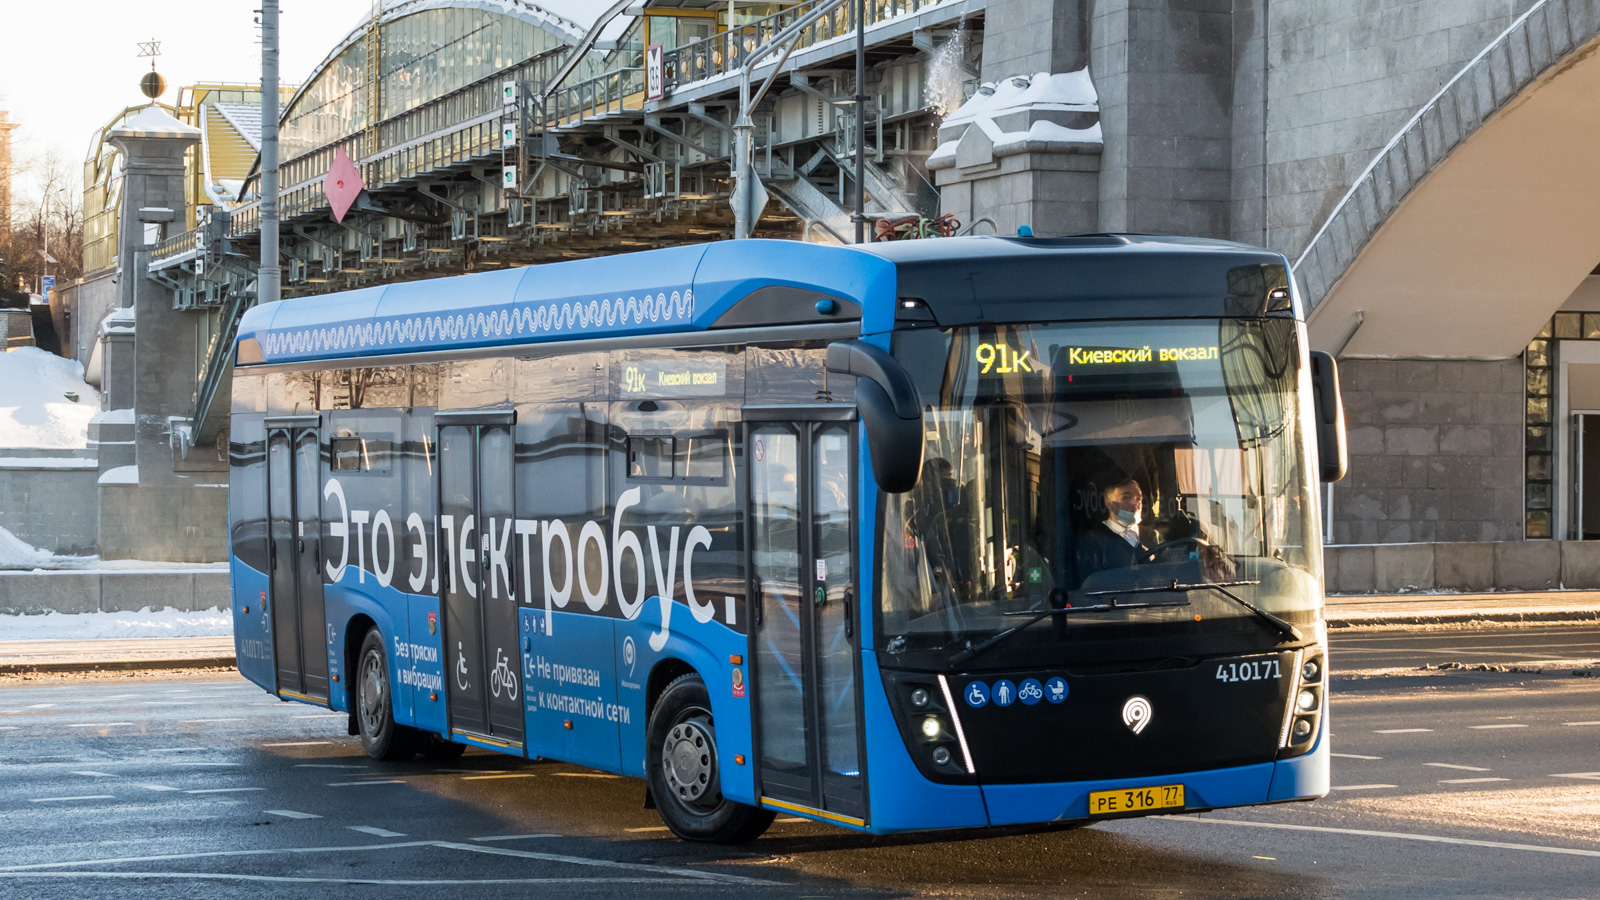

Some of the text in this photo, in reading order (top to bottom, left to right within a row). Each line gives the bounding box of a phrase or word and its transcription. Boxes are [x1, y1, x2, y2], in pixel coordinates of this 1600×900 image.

[975, 343, 1032, 374] 91к
[1069, 345, 1219, 365] Киевский вокзал
[626, 366, 646, 393] 91к
[658, 371, 717, 386] Киевский вокзал
[323, 478, 737, 652] Это электробус.
[241, 638, 264, 660] 410171
[394, 635, 438, 664] Без тряски
[402, 665, 442, 693] вибраций
[536, 655, 601, 688] Не привязан
[1215, 660, 1282, 682] 410171
[546, 693, 605, 720] контактной
[605, 703, 631, 725] сети
[1125, 790, 1155, 809] 316
[1163, 786, 1178, 801] 77
